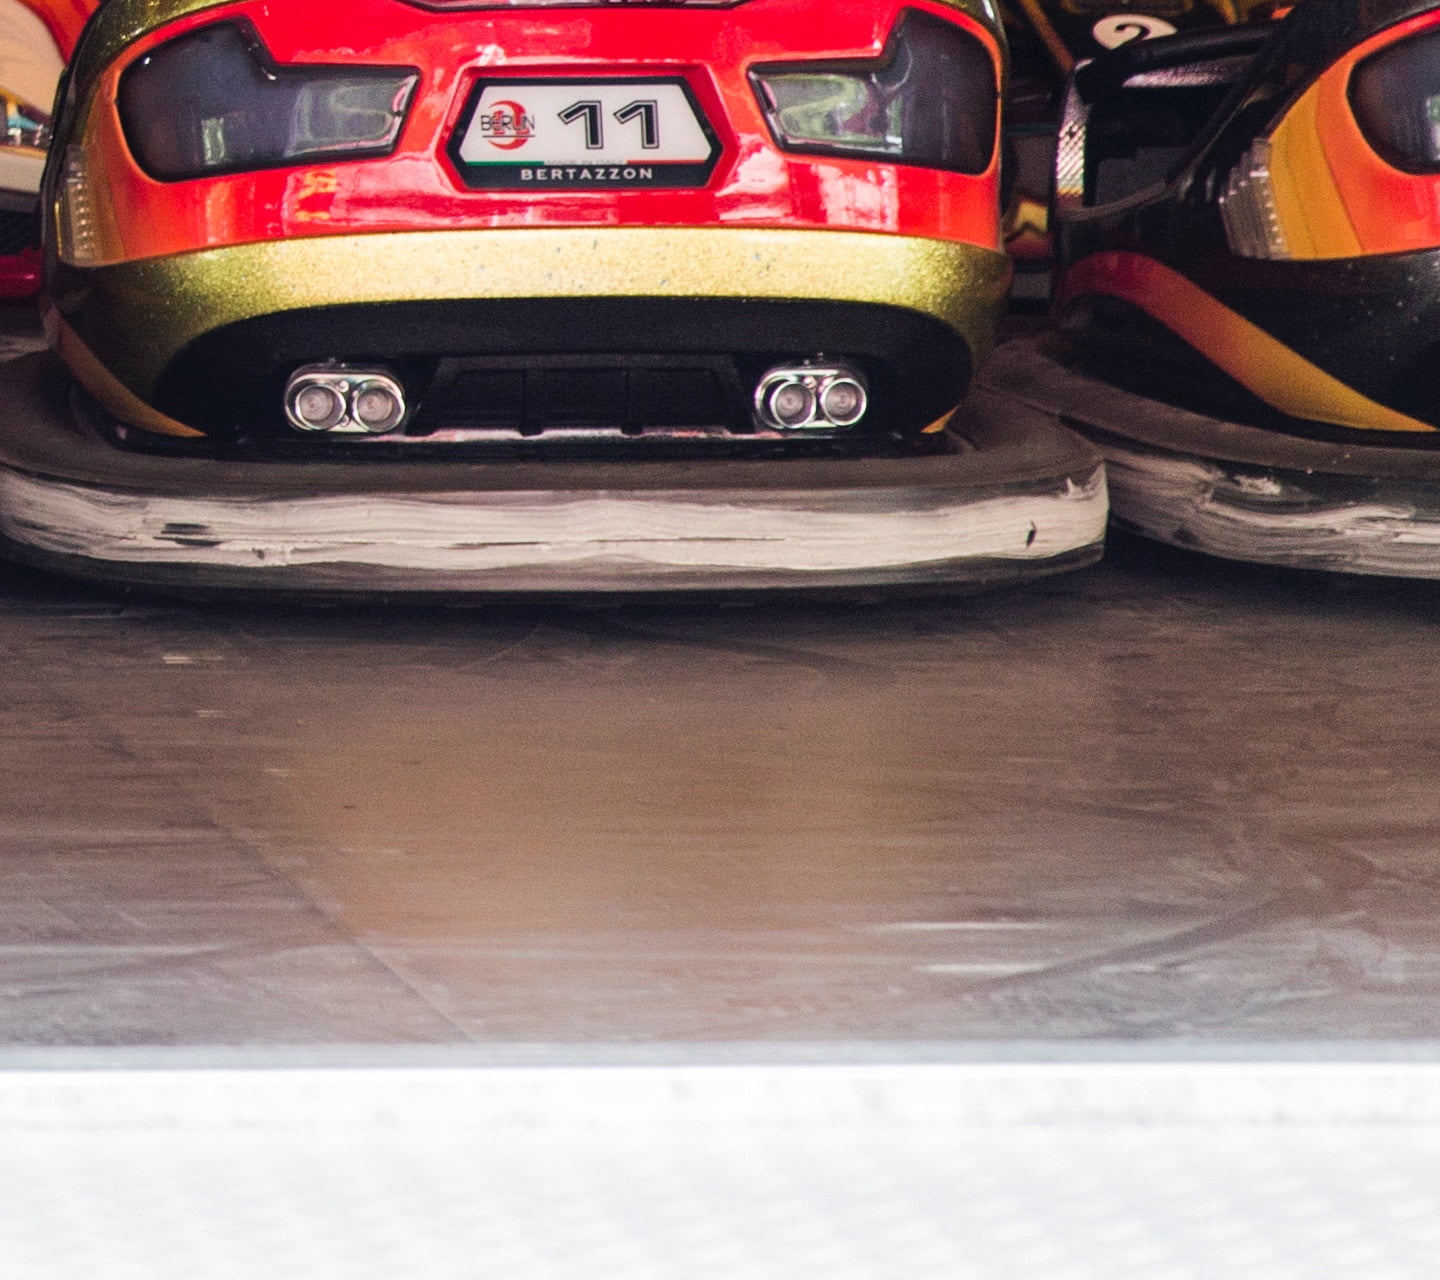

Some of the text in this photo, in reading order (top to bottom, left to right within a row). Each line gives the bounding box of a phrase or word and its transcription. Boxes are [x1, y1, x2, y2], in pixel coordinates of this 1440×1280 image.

[480, 100, 660, 150] BERLIN 11
[520, 168, 653, 181] BERTAZZON
